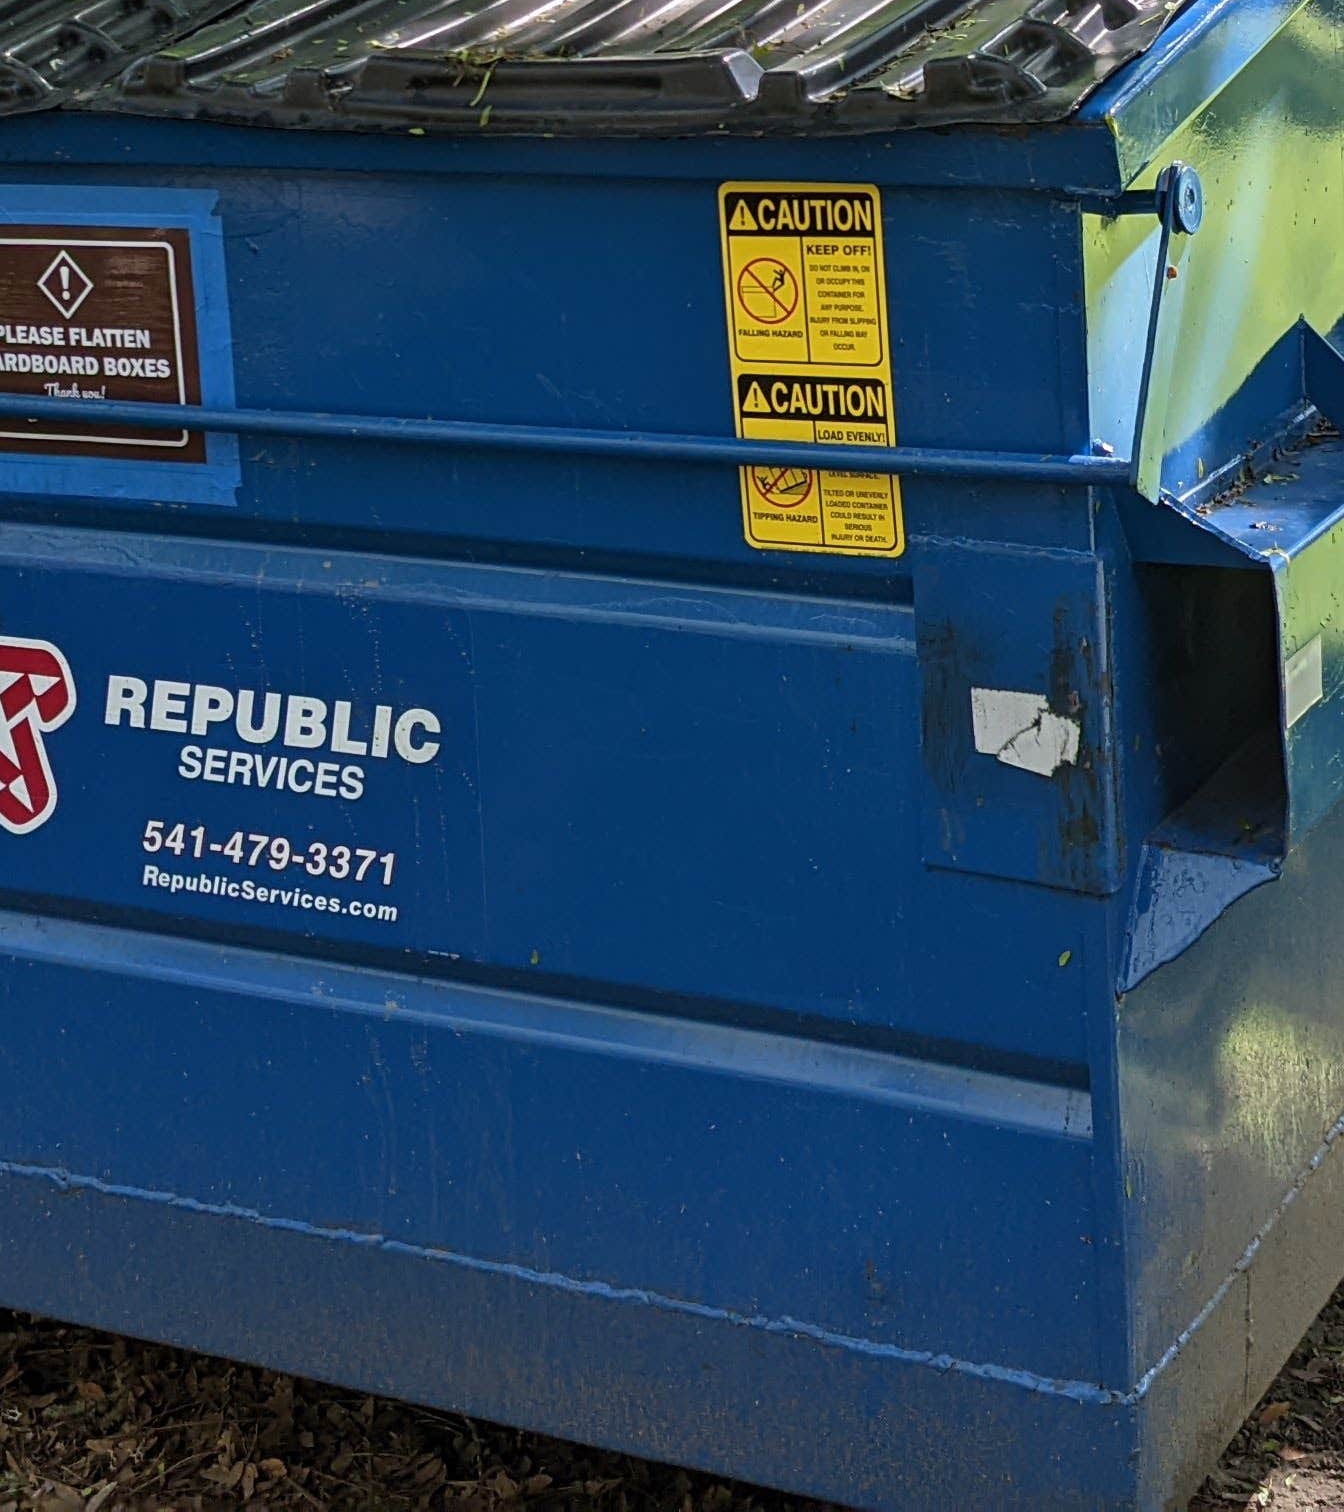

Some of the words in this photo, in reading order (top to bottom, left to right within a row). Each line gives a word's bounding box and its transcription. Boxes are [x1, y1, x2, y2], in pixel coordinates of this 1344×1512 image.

[757, 198, 872, 232] CAUTION
[806, 245, 839, 256] KEEP
[843, 245, 871, 256] OFF!
[68, 327, 151, 349] FLATTEN
[738, 329, 770, 337] FALLING
[772, 330, 803, 338] HAZARD
[103, 357, 171, 378] BOXES
[44, 382, 81, 400] Thank
[770, 381, 885, 417] CAUTION
[818, 430, 844, 441] LOAD
[846, 431, 886, 443] EVENLY!
[753, 512, 785, 522] TIPPING
[786, 513, 818, 523] HAZARD
[104, 674, 441, 764] REPUBLIC
[177, 744, 366, 801] SERVICES
[141, 819, 397, 887] 541-479-3371
[141, 864, 399, 922] RepublicServices.com
